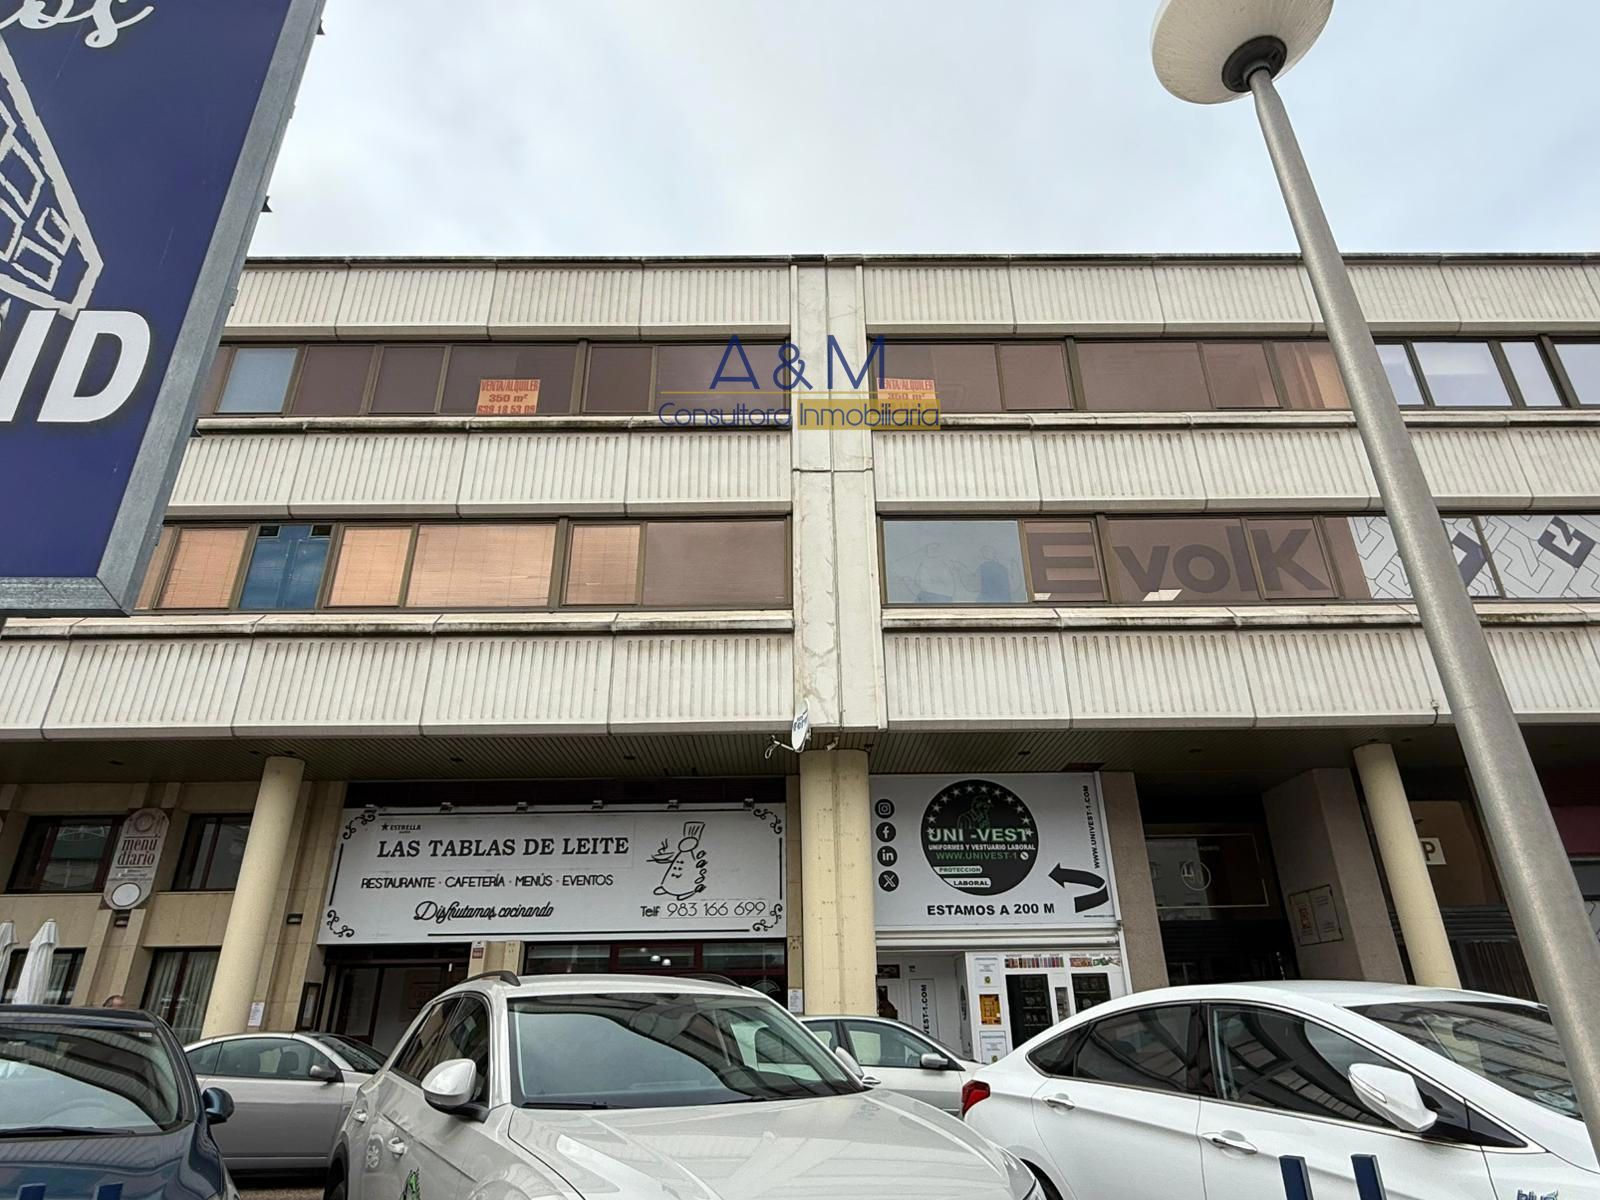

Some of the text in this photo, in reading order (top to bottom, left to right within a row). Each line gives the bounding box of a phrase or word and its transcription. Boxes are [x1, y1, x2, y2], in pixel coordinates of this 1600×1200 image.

[489, 394, 510, 402] 350
[377, 837, 629, 857] LAS TABLAS DE LEITE
[117, 851, 156, 866] diario
[361, 873, 614, 889] RESTAURANTE CAFETERÍA MENÚS EVENTOS
[413, 901, 554, 924] Disfrutamos cocinando
[640, 901, 766, 917] Telf 983 166 699
[927, 903, 1055, 915] ESTAMOS A 200 M
